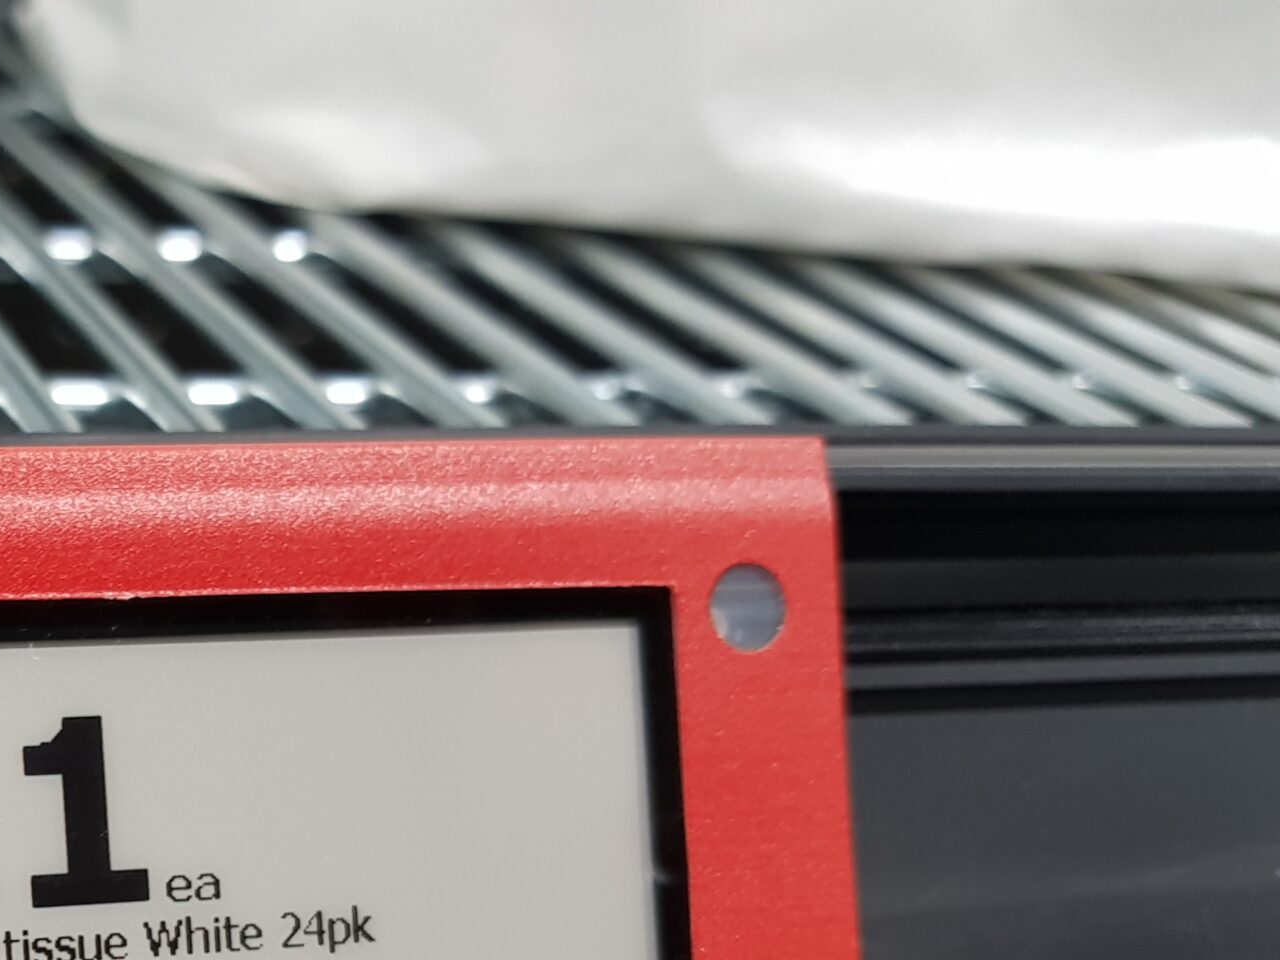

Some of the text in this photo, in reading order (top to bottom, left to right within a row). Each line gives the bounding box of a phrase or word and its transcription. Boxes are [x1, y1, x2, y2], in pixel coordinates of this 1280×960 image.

[166, 872, 221, 902] ea
[143, 916, 263, 957] White
[281, 905, 376, 953] 24pk
